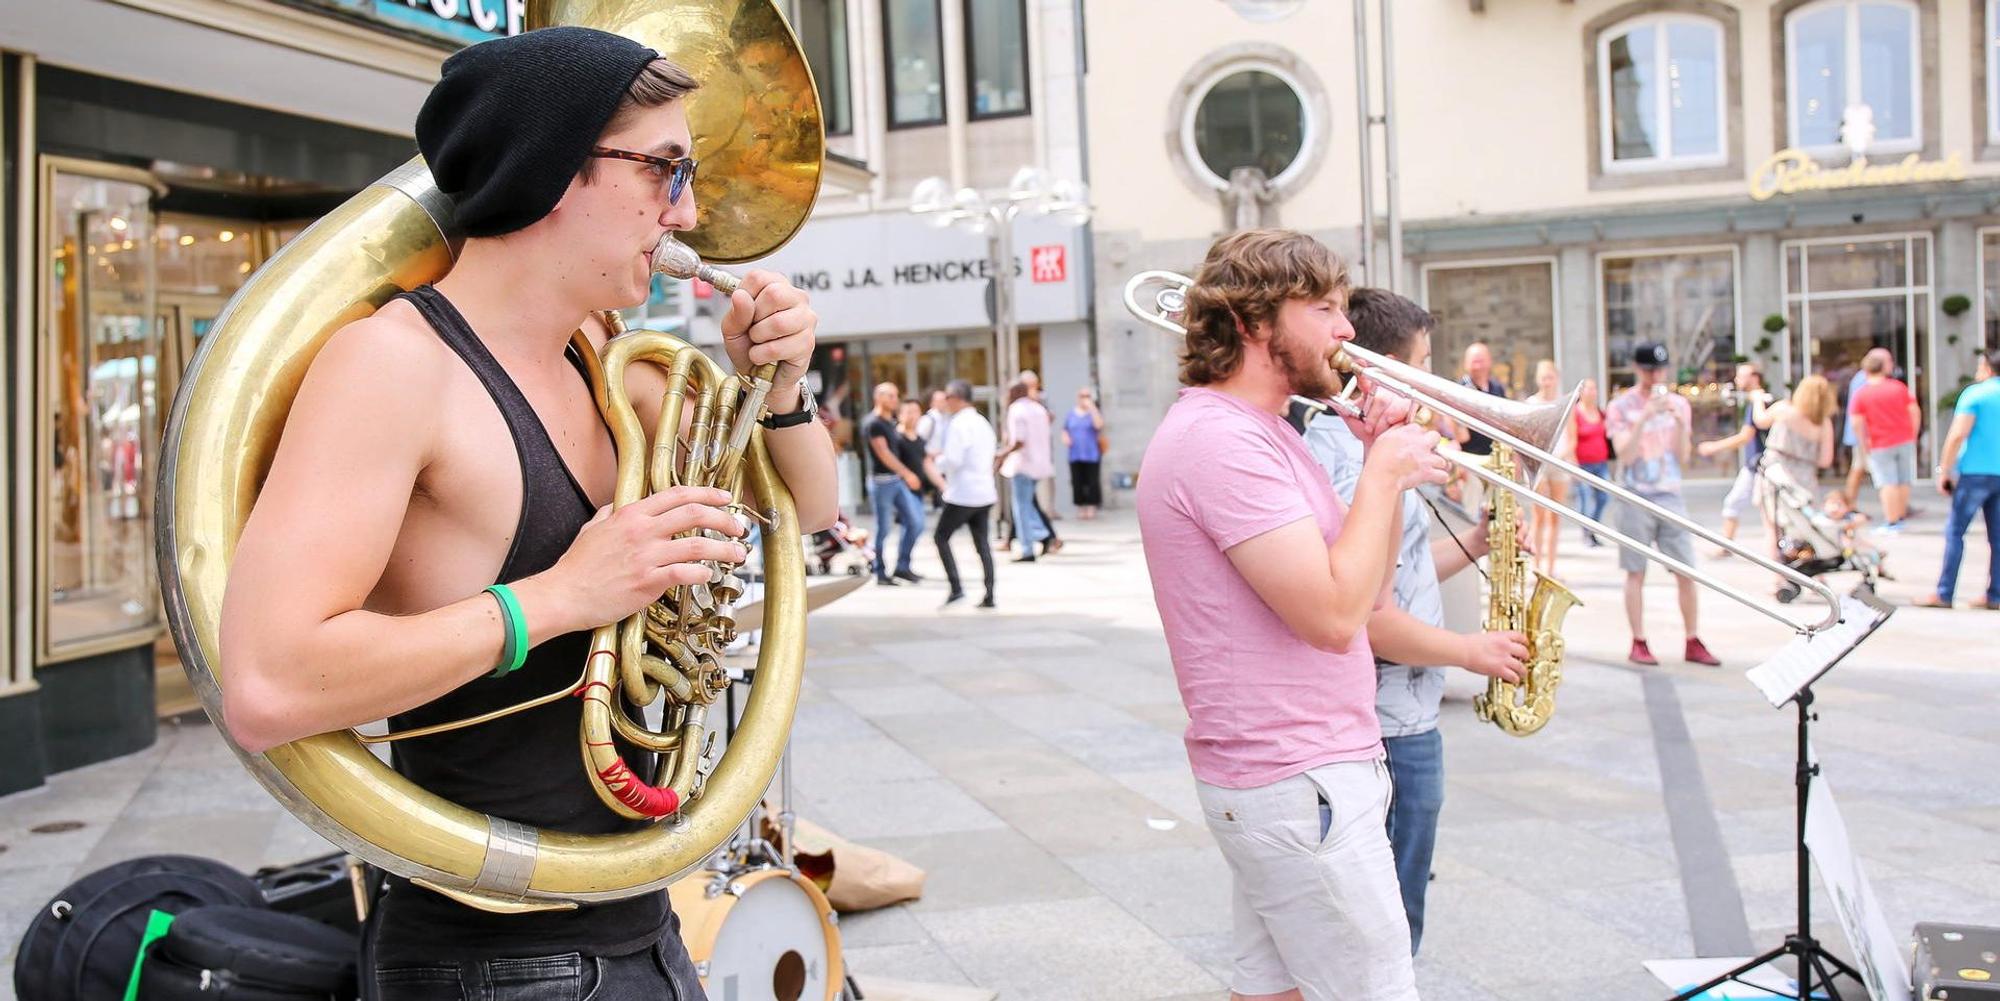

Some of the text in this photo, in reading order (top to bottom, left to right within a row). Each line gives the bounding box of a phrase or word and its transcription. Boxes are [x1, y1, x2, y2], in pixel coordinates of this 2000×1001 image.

[792, 257, 1022, 290] ING J.A. HENCKES
